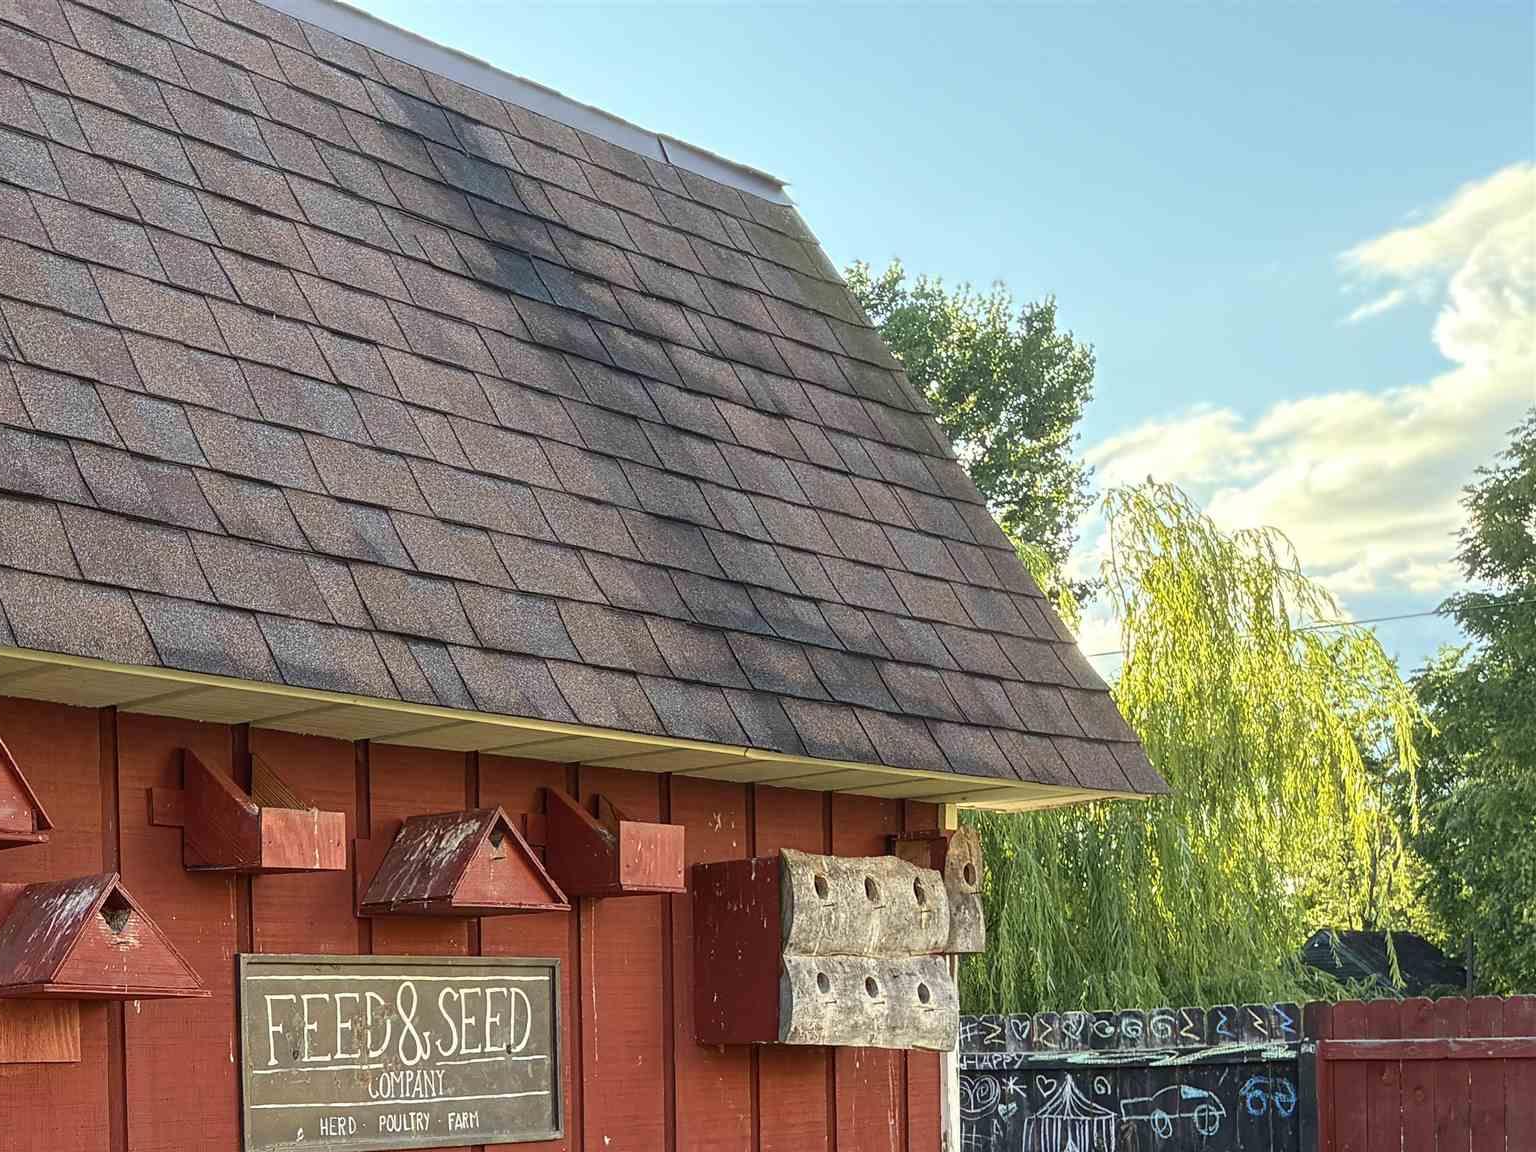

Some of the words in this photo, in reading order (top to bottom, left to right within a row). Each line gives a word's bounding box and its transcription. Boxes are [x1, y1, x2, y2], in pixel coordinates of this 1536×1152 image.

[368, 1070, 445, 1098] COMPANY
[320, 1116, 357, 1136] HERD
[379, 1112, 430, 1132] POULTRY
[448, 1112, 479, 1130] FARM
